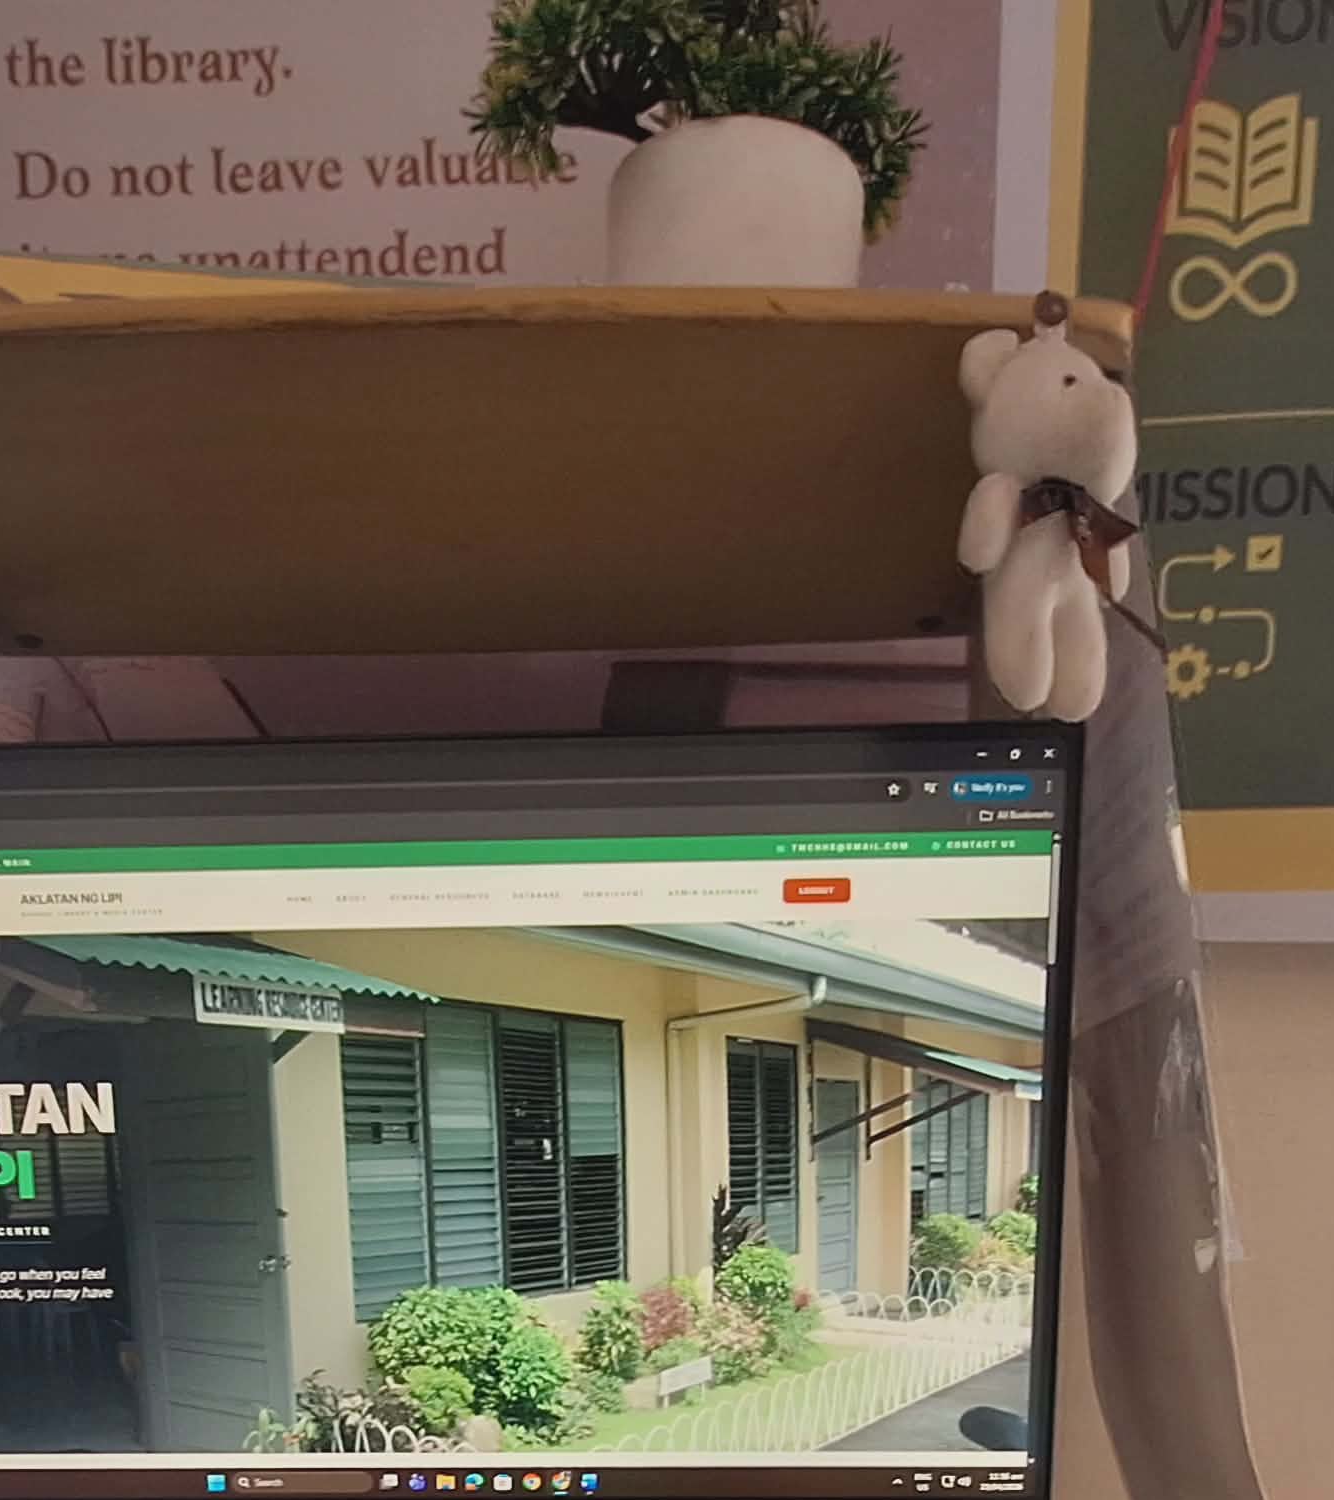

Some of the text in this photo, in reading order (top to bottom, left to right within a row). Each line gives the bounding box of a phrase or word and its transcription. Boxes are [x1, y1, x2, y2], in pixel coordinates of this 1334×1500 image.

[5, 36, 294, 95] the library.
[15, 137, 579, 201] Do not leave valuae
[21, 893, 78, 904] AKLATAN
[0, 1272, 16, 1283] go
[55, 1271, 79, 1283] you
[26, 1289, 50, 1301] you
[81, 1287, 114, 1299] have
